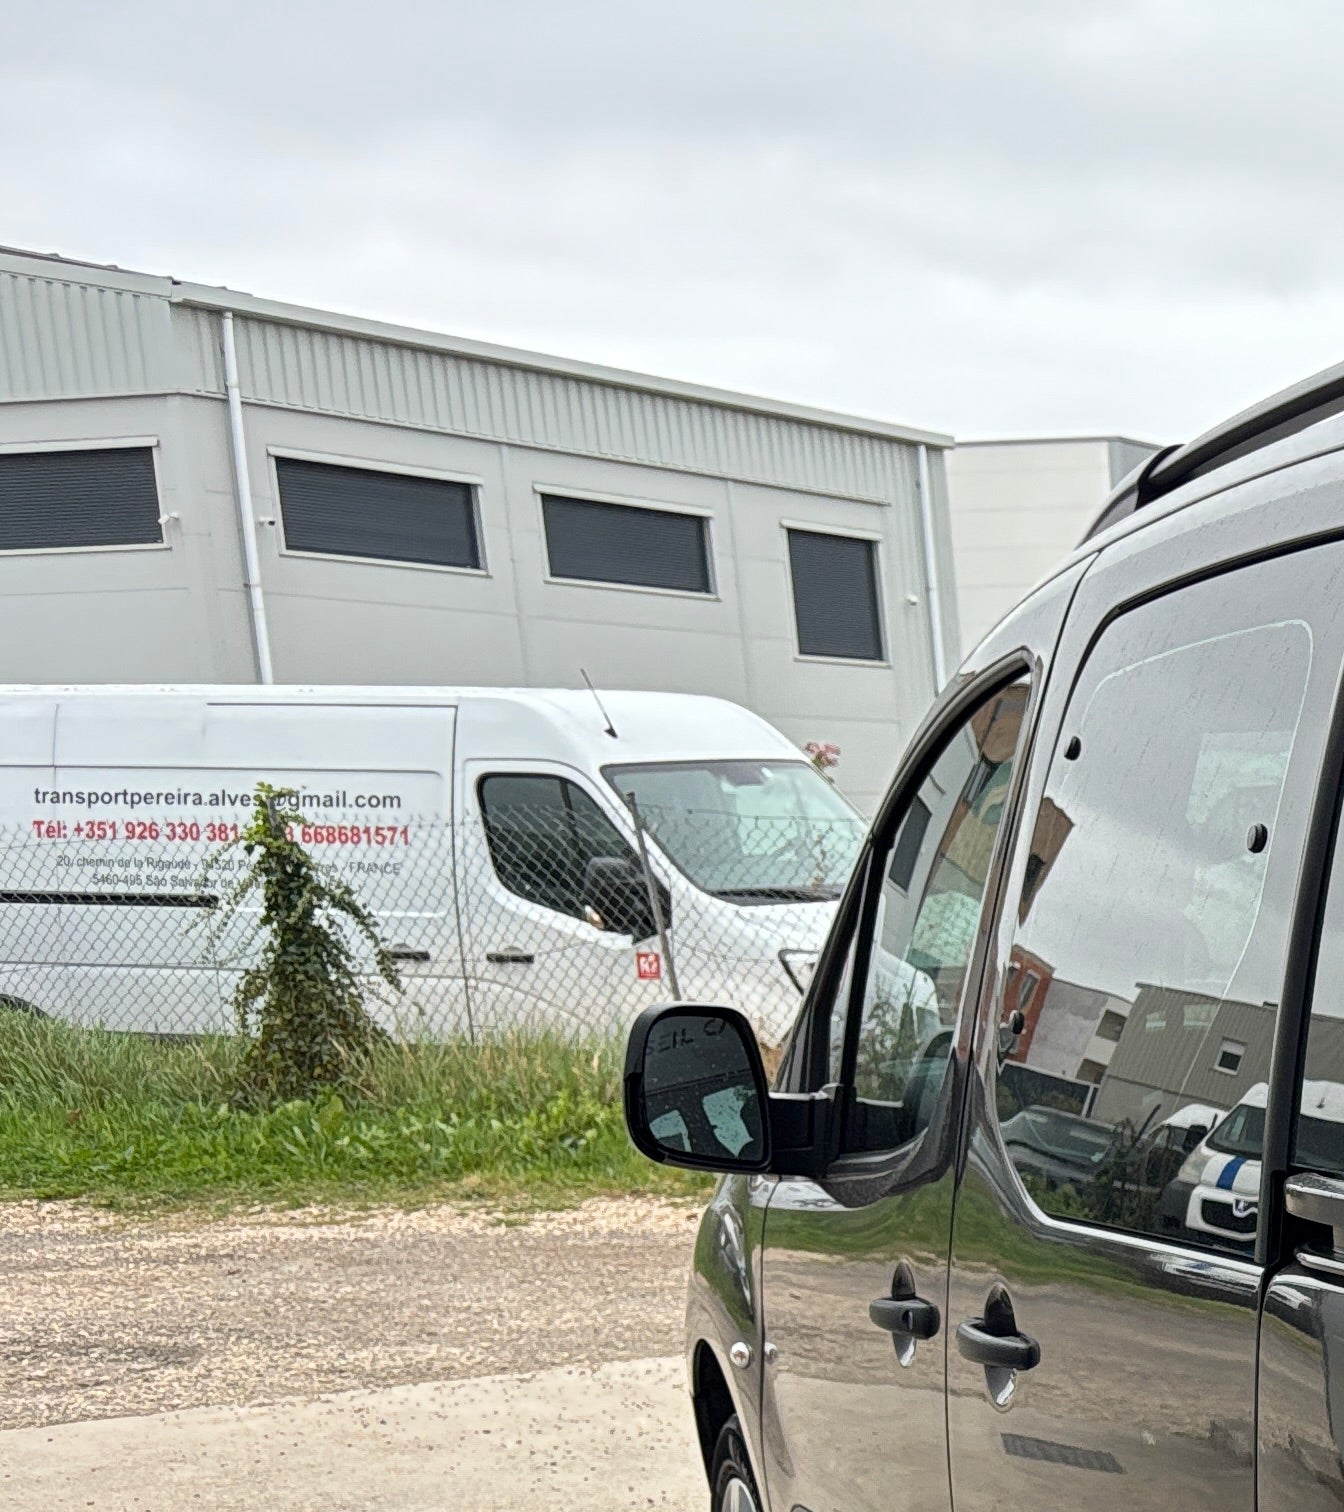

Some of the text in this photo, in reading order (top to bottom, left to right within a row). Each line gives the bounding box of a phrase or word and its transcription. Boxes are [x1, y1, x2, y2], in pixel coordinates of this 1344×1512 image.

[74, 820, 117, 840] +351
[125, 820, 159, 840] 926
[166, 821, 200, 842] 330
[206, 822, 240, 842] 381
[302, 825, 410, 846] 668681571
[350, 861, 401, 875] FRANCE
